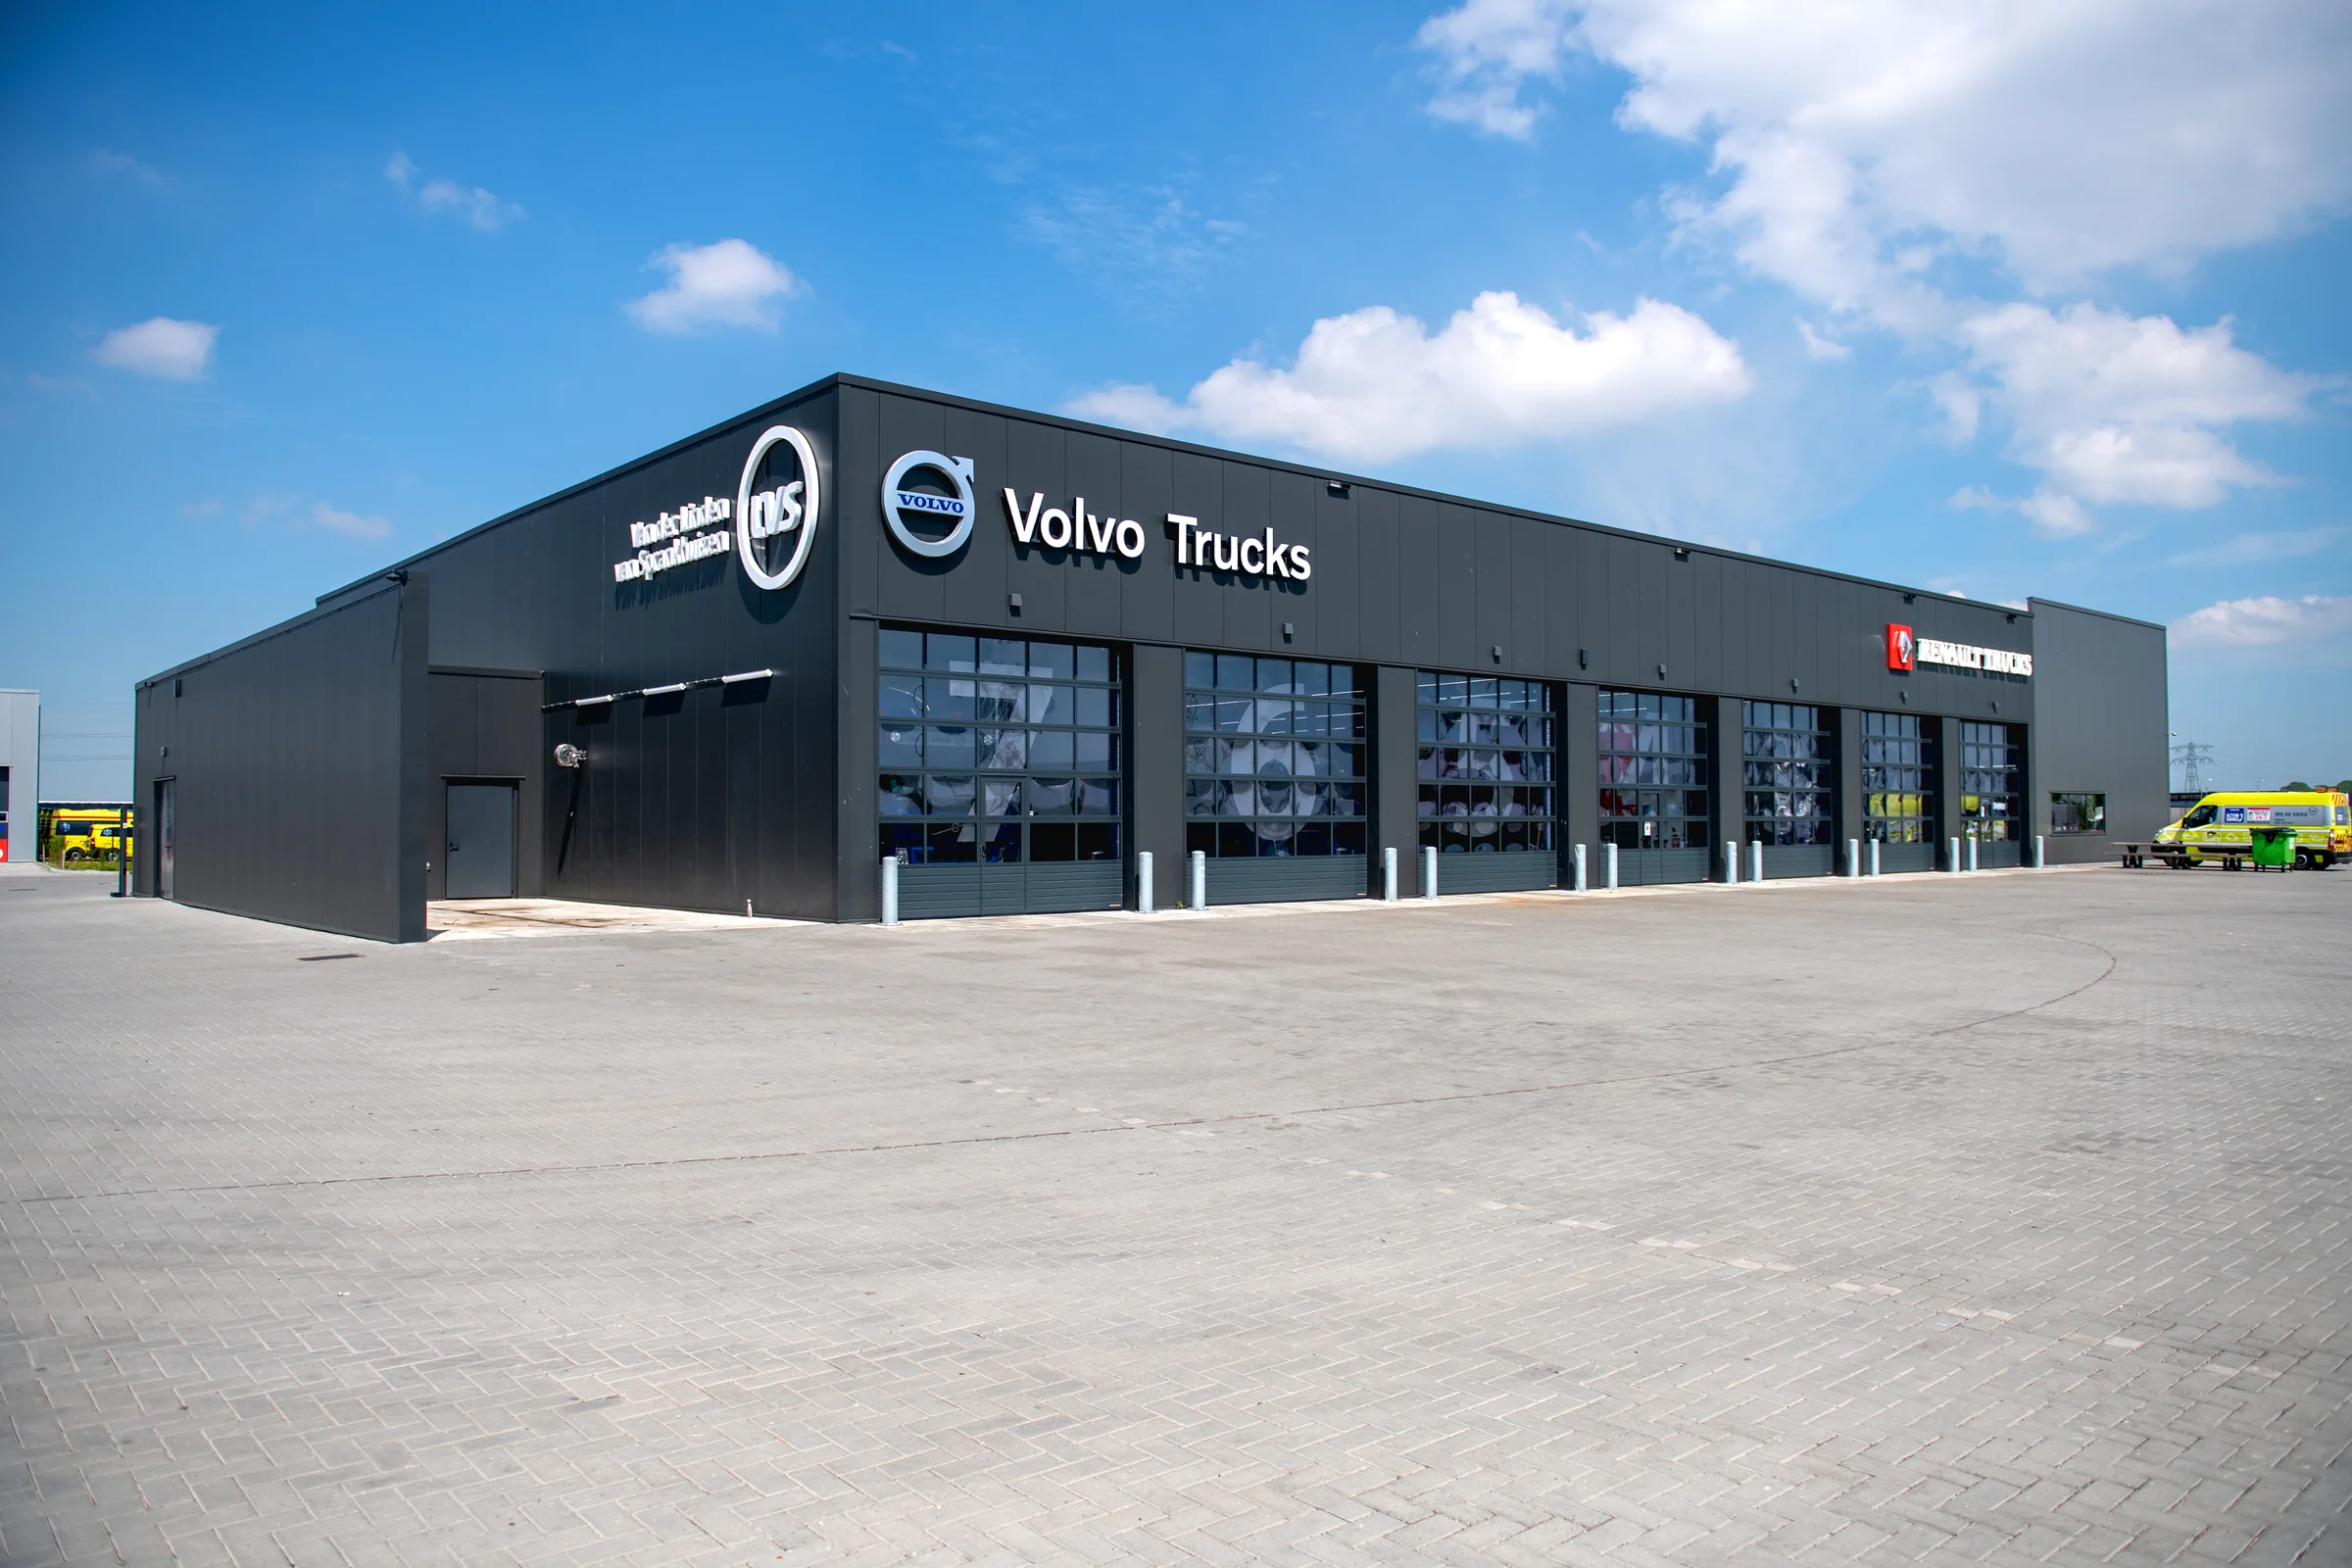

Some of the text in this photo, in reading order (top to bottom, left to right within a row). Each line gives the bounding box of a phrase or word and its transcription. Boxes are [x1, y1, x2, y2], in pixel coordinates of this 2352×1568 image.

[680, 496, 731, 533] Linden
[897, 493, 965, 514] VOLVO
[1003, 487, 1312, 581] Volvo Trucks
[1916, 638, 2033, 677] RENAULT TRUCKS
[949, 660, 1054, 843] 7
[1230, 682, 1316, 841] 6
